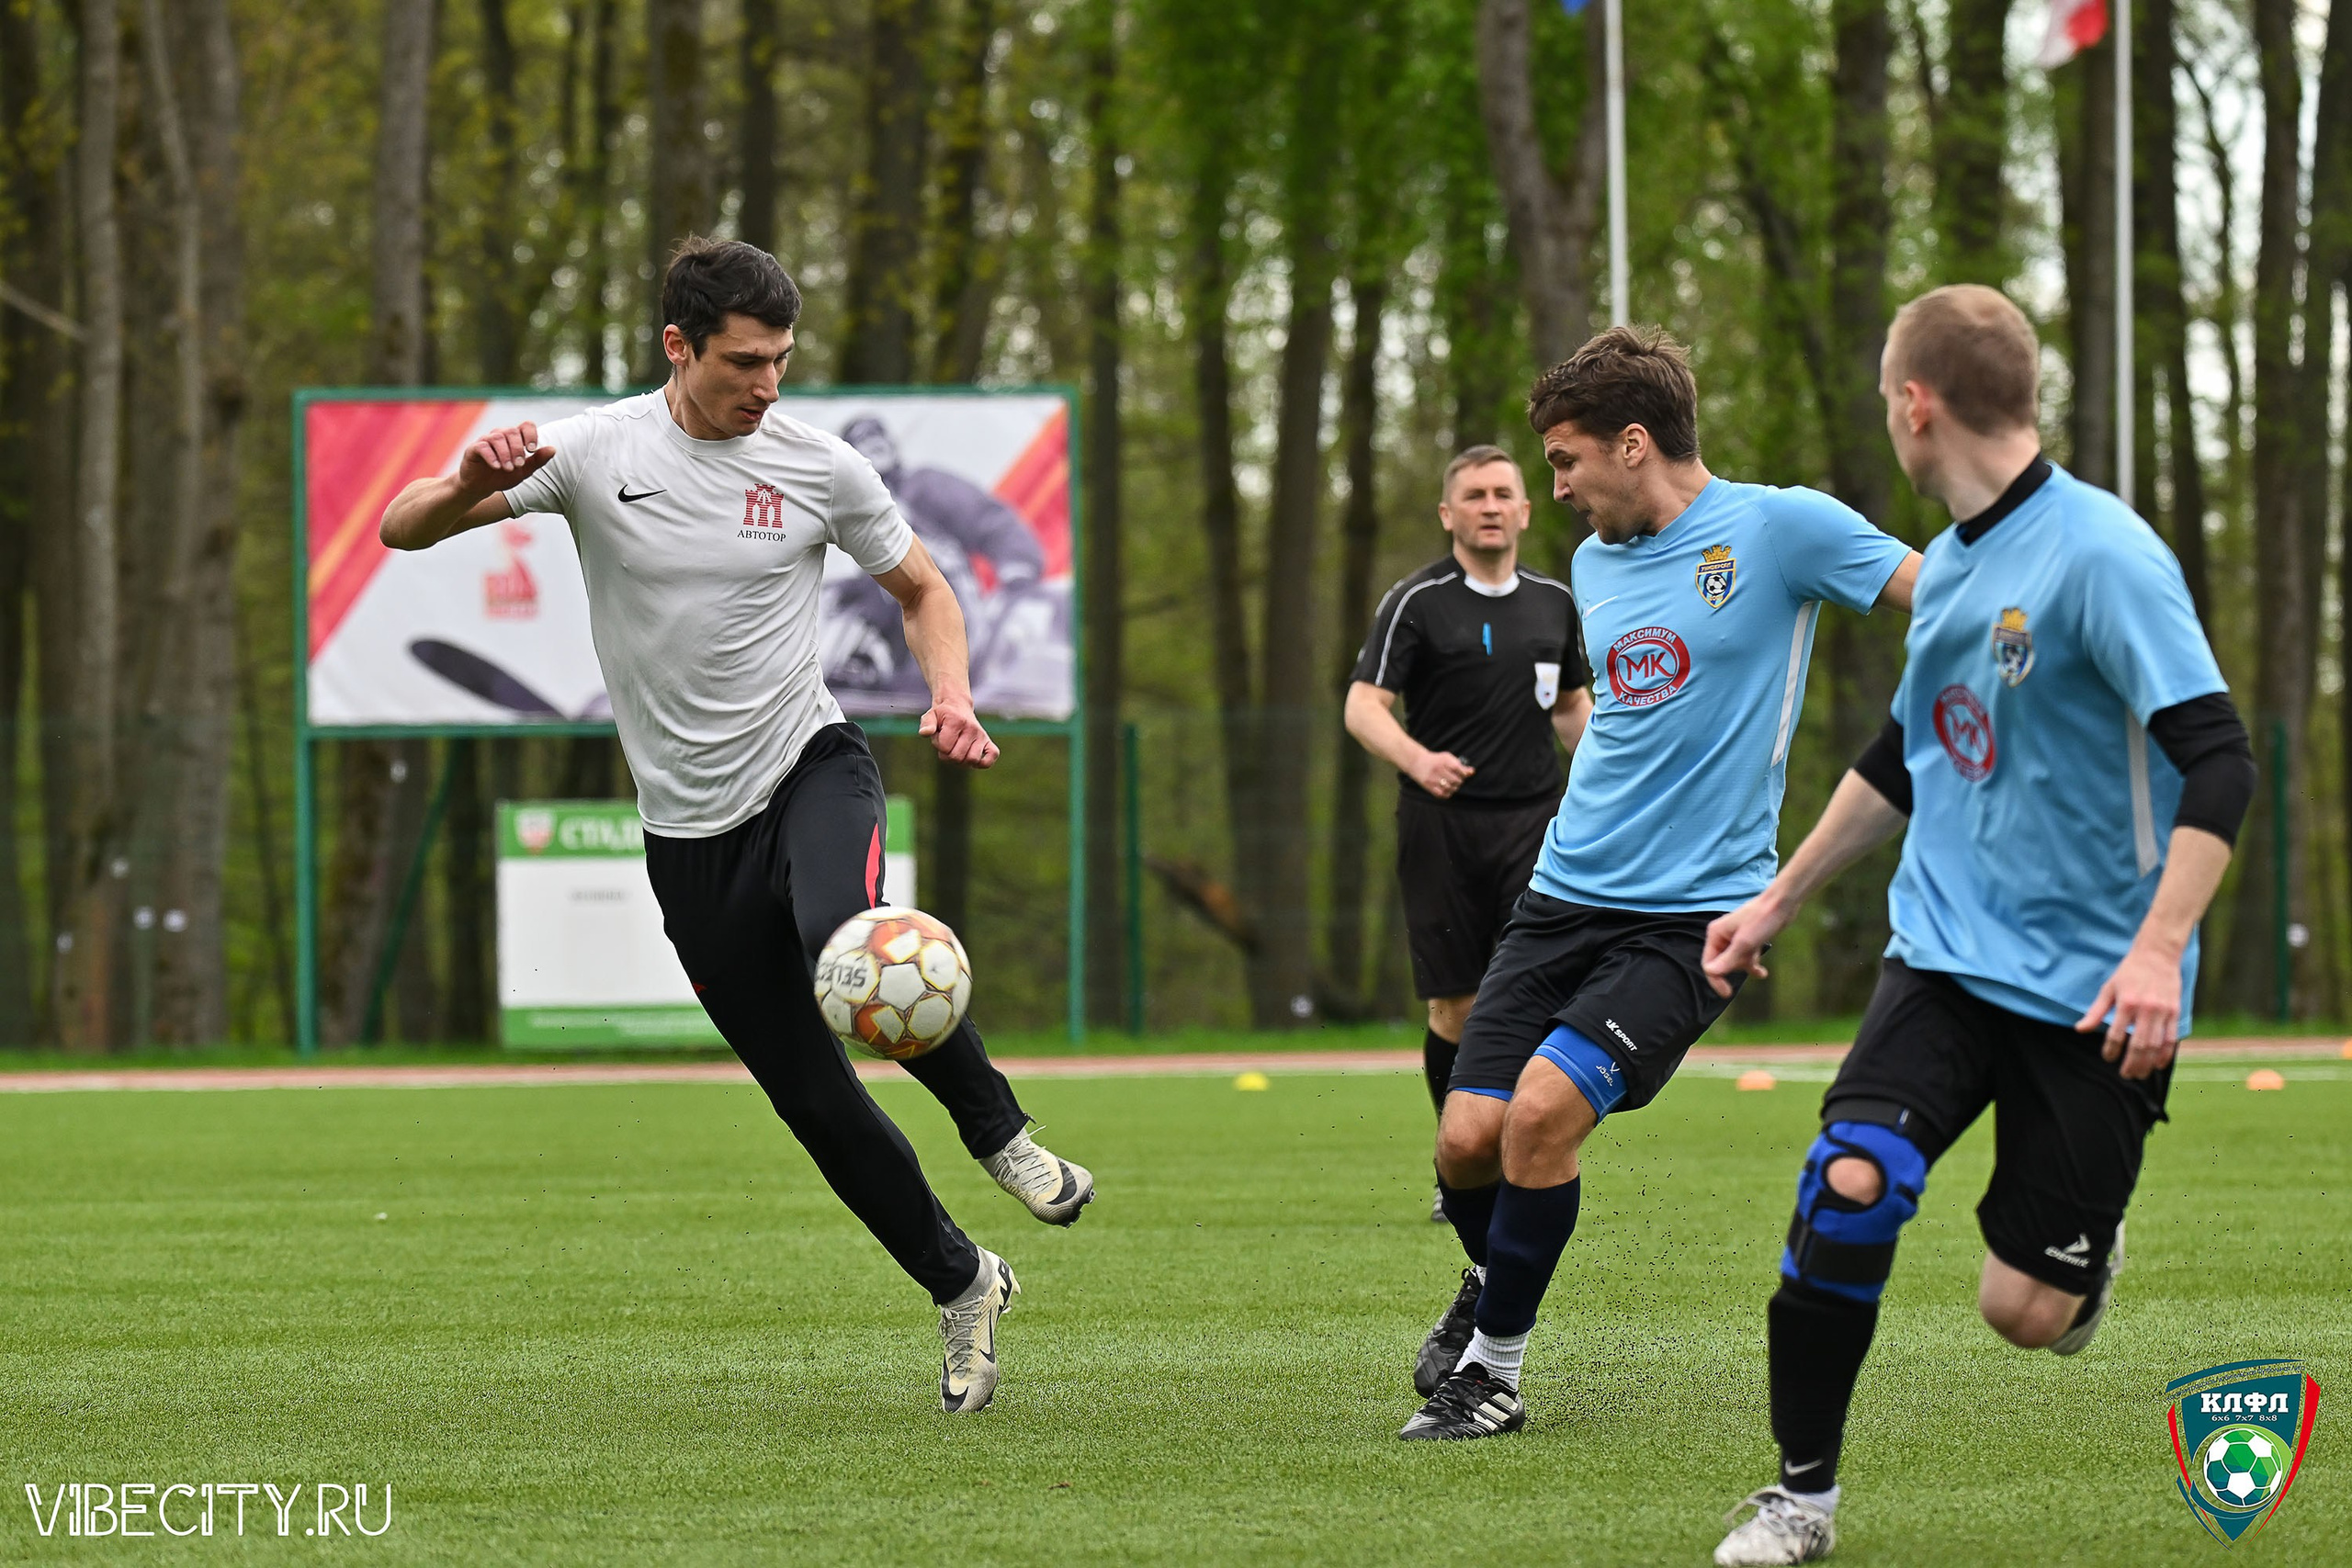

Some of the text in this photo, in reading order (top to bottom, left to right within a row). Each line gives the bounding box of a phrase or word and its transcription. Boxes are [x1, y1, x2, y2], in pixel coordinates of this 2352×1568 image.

[737, 529, 786, 542] АВТОТОР
[1612, 627, 1677, 652] МАКСИМУМ
[1619, 652, 1674, 682] МК
[1618, 685, 1677, 705] КАЧЕСТВА
[1614, 1029, 1638, 1051] SPORT
[1595, 1065, 1613, 1087] JÖGEL
